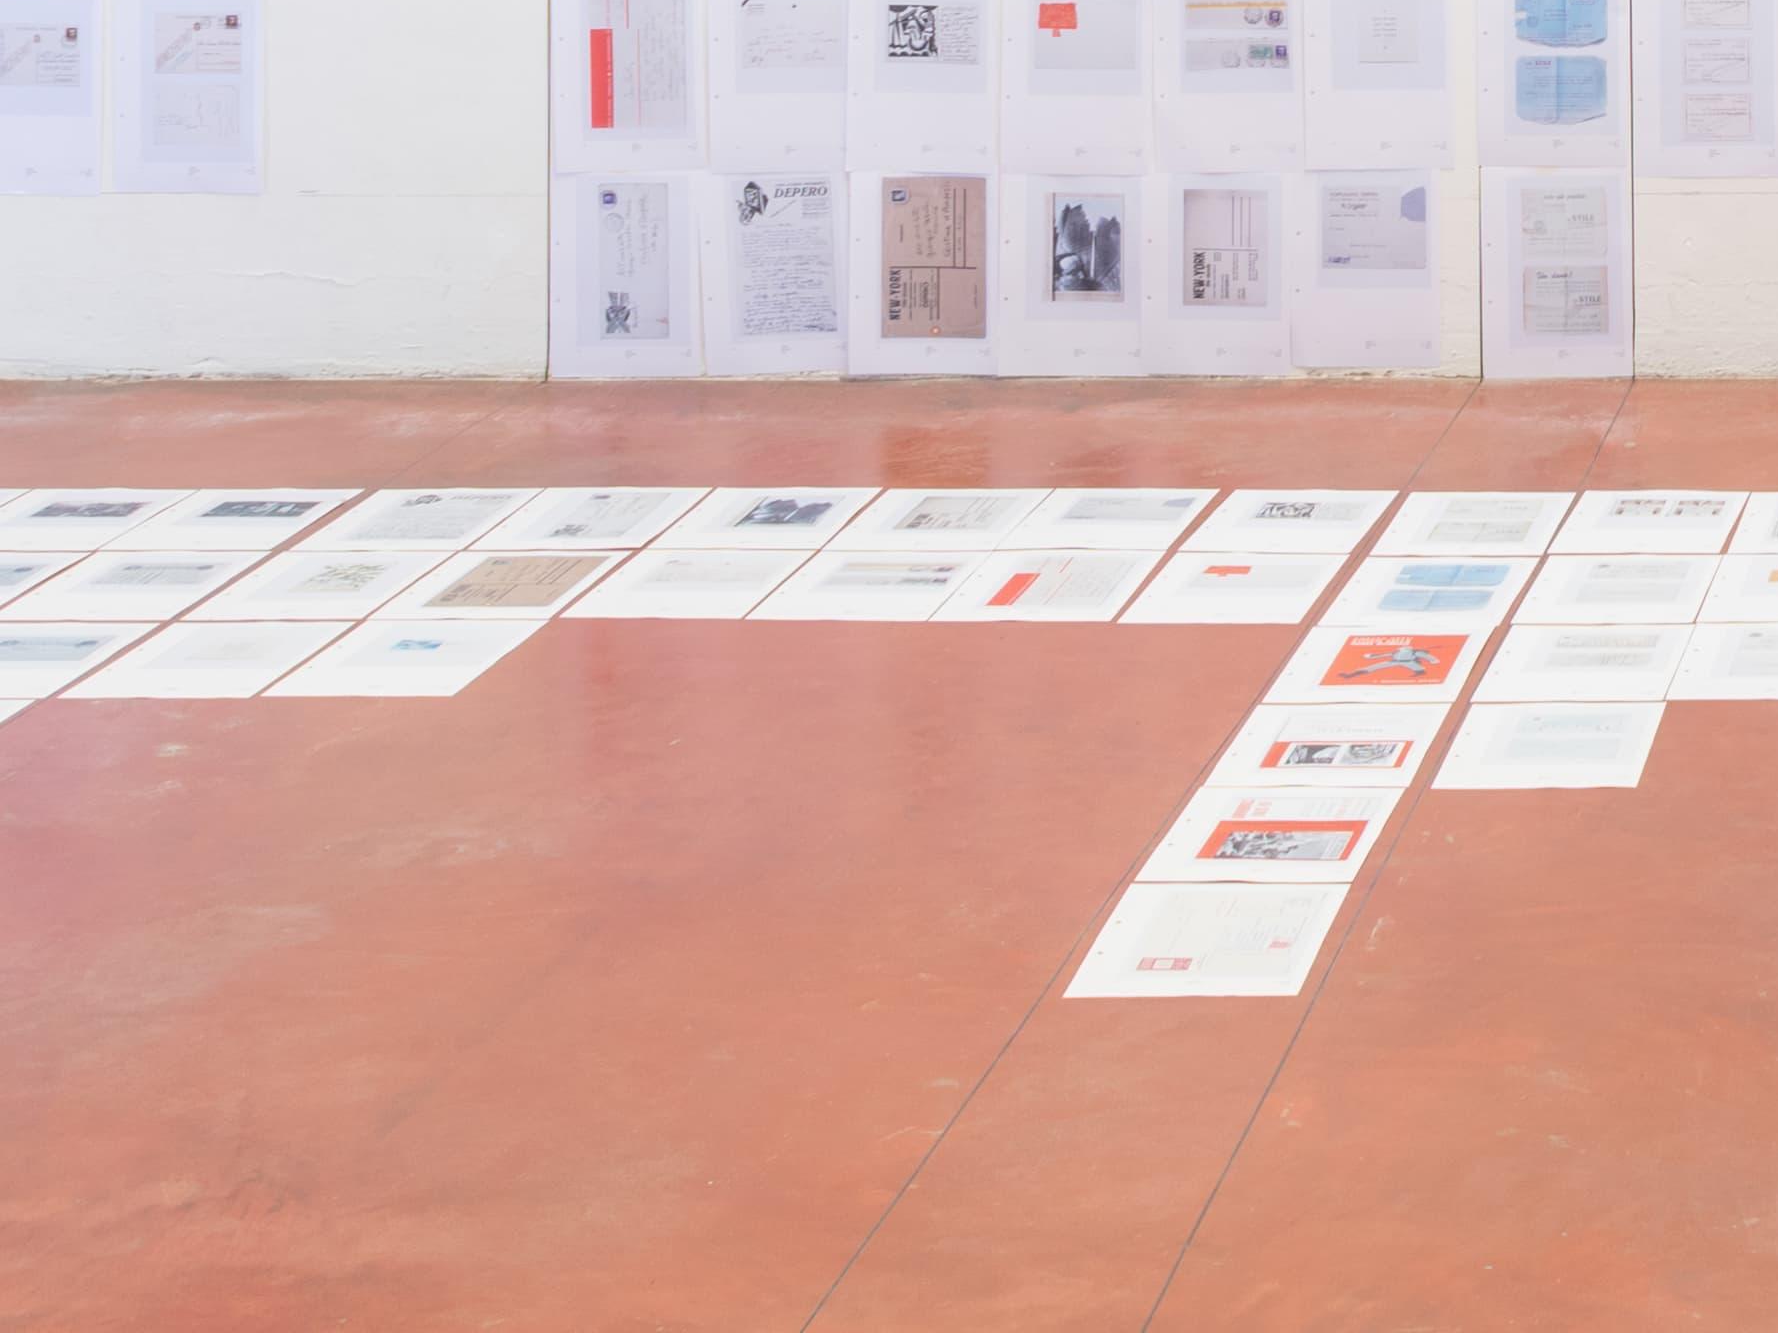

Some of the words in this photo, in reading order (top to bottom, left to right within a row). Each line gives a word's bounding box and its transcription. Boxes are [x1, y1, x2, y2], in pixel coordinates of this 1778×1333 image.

[773, 186, 828, 199] DEPERO
[888, 267, 900, 321] NEW-YORK
[1193, 251, 1205, 299] NEW-YORK
